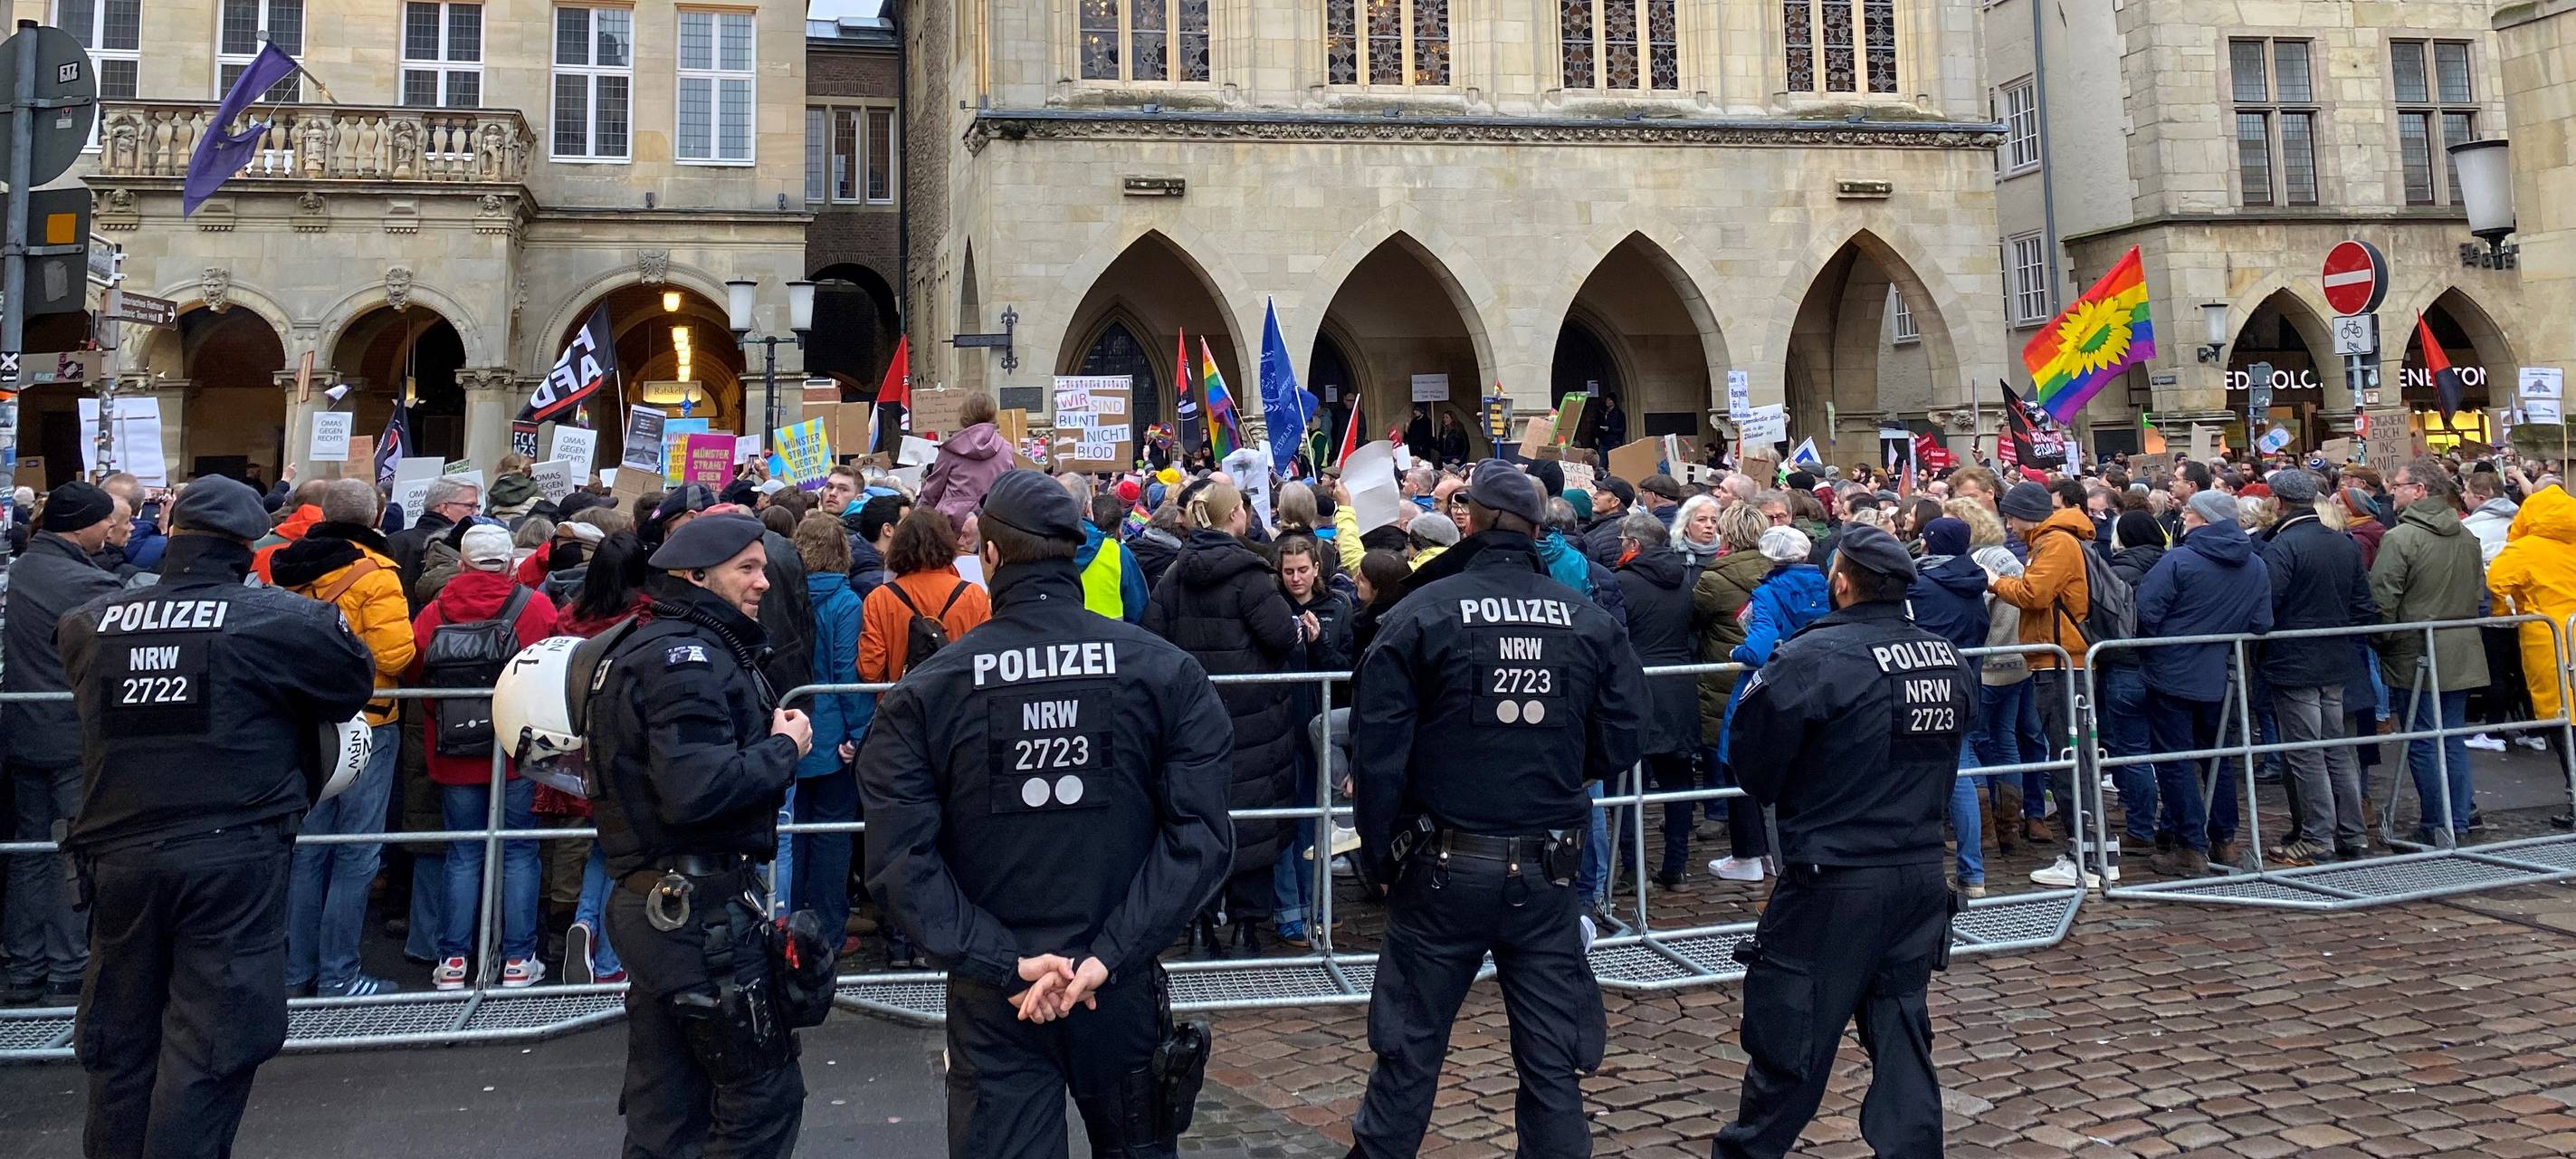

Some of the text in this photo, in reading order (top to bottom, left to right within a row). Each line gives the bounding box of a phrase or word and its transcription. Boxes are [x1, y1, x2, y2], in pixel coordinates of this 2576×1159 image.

[1060, 393, 1122, 412] WIR SIND
[1059, 415, 1097, 426] BUNT
[514, 432, 536, 445] FCK
[563, 436, 586, 445] OMAS
[1086, 427, 1127, 443] NICHT
[2372, 427, 2399, 440] EUCH
[560, 445, 586, 455] GEGEN
[784, 433, 820, 451] MÜNSTER
[2379, 441, 2397, 453] INS
[514, 445, 536, 457] NZS
[692, 447, 730, 459] MÜNSTER
[787, 444, 820, 460] STRAHLT
[1077, 443, 1112, 458] BLÖD
[693, 460, 727, 470] STRAHLT
[795, 455, 818, 468] GEGEN
[535, 472, 561, 482] OMAS
[697, 472, 721, 481] GEGEN
[538, 481, 564, 490] EGEN
[409, 490, 427, 498] OMA
[97, 600, 228, 632] POLIZEI
[1460, 598, 1572, 626] POLIZEI
[1499, 637, 1542, 660] NRW
[1872, 641, 1958, 672] POLIZEI
[129, 646, 180, 671] NRW
[974, 643, 1116, 685] POLIZEI
[1493, 668, 1551, 694] 2723
[122, 676, 187, 704] 2722
[1904, 678, 1951, 704] NRW
[1023, 700, 1079, 731] NRW
[1911, 707, 1954, 732] 2723
[348, 730, 362, 769] NRW
[1015, 735, 1090, 771] 2723
